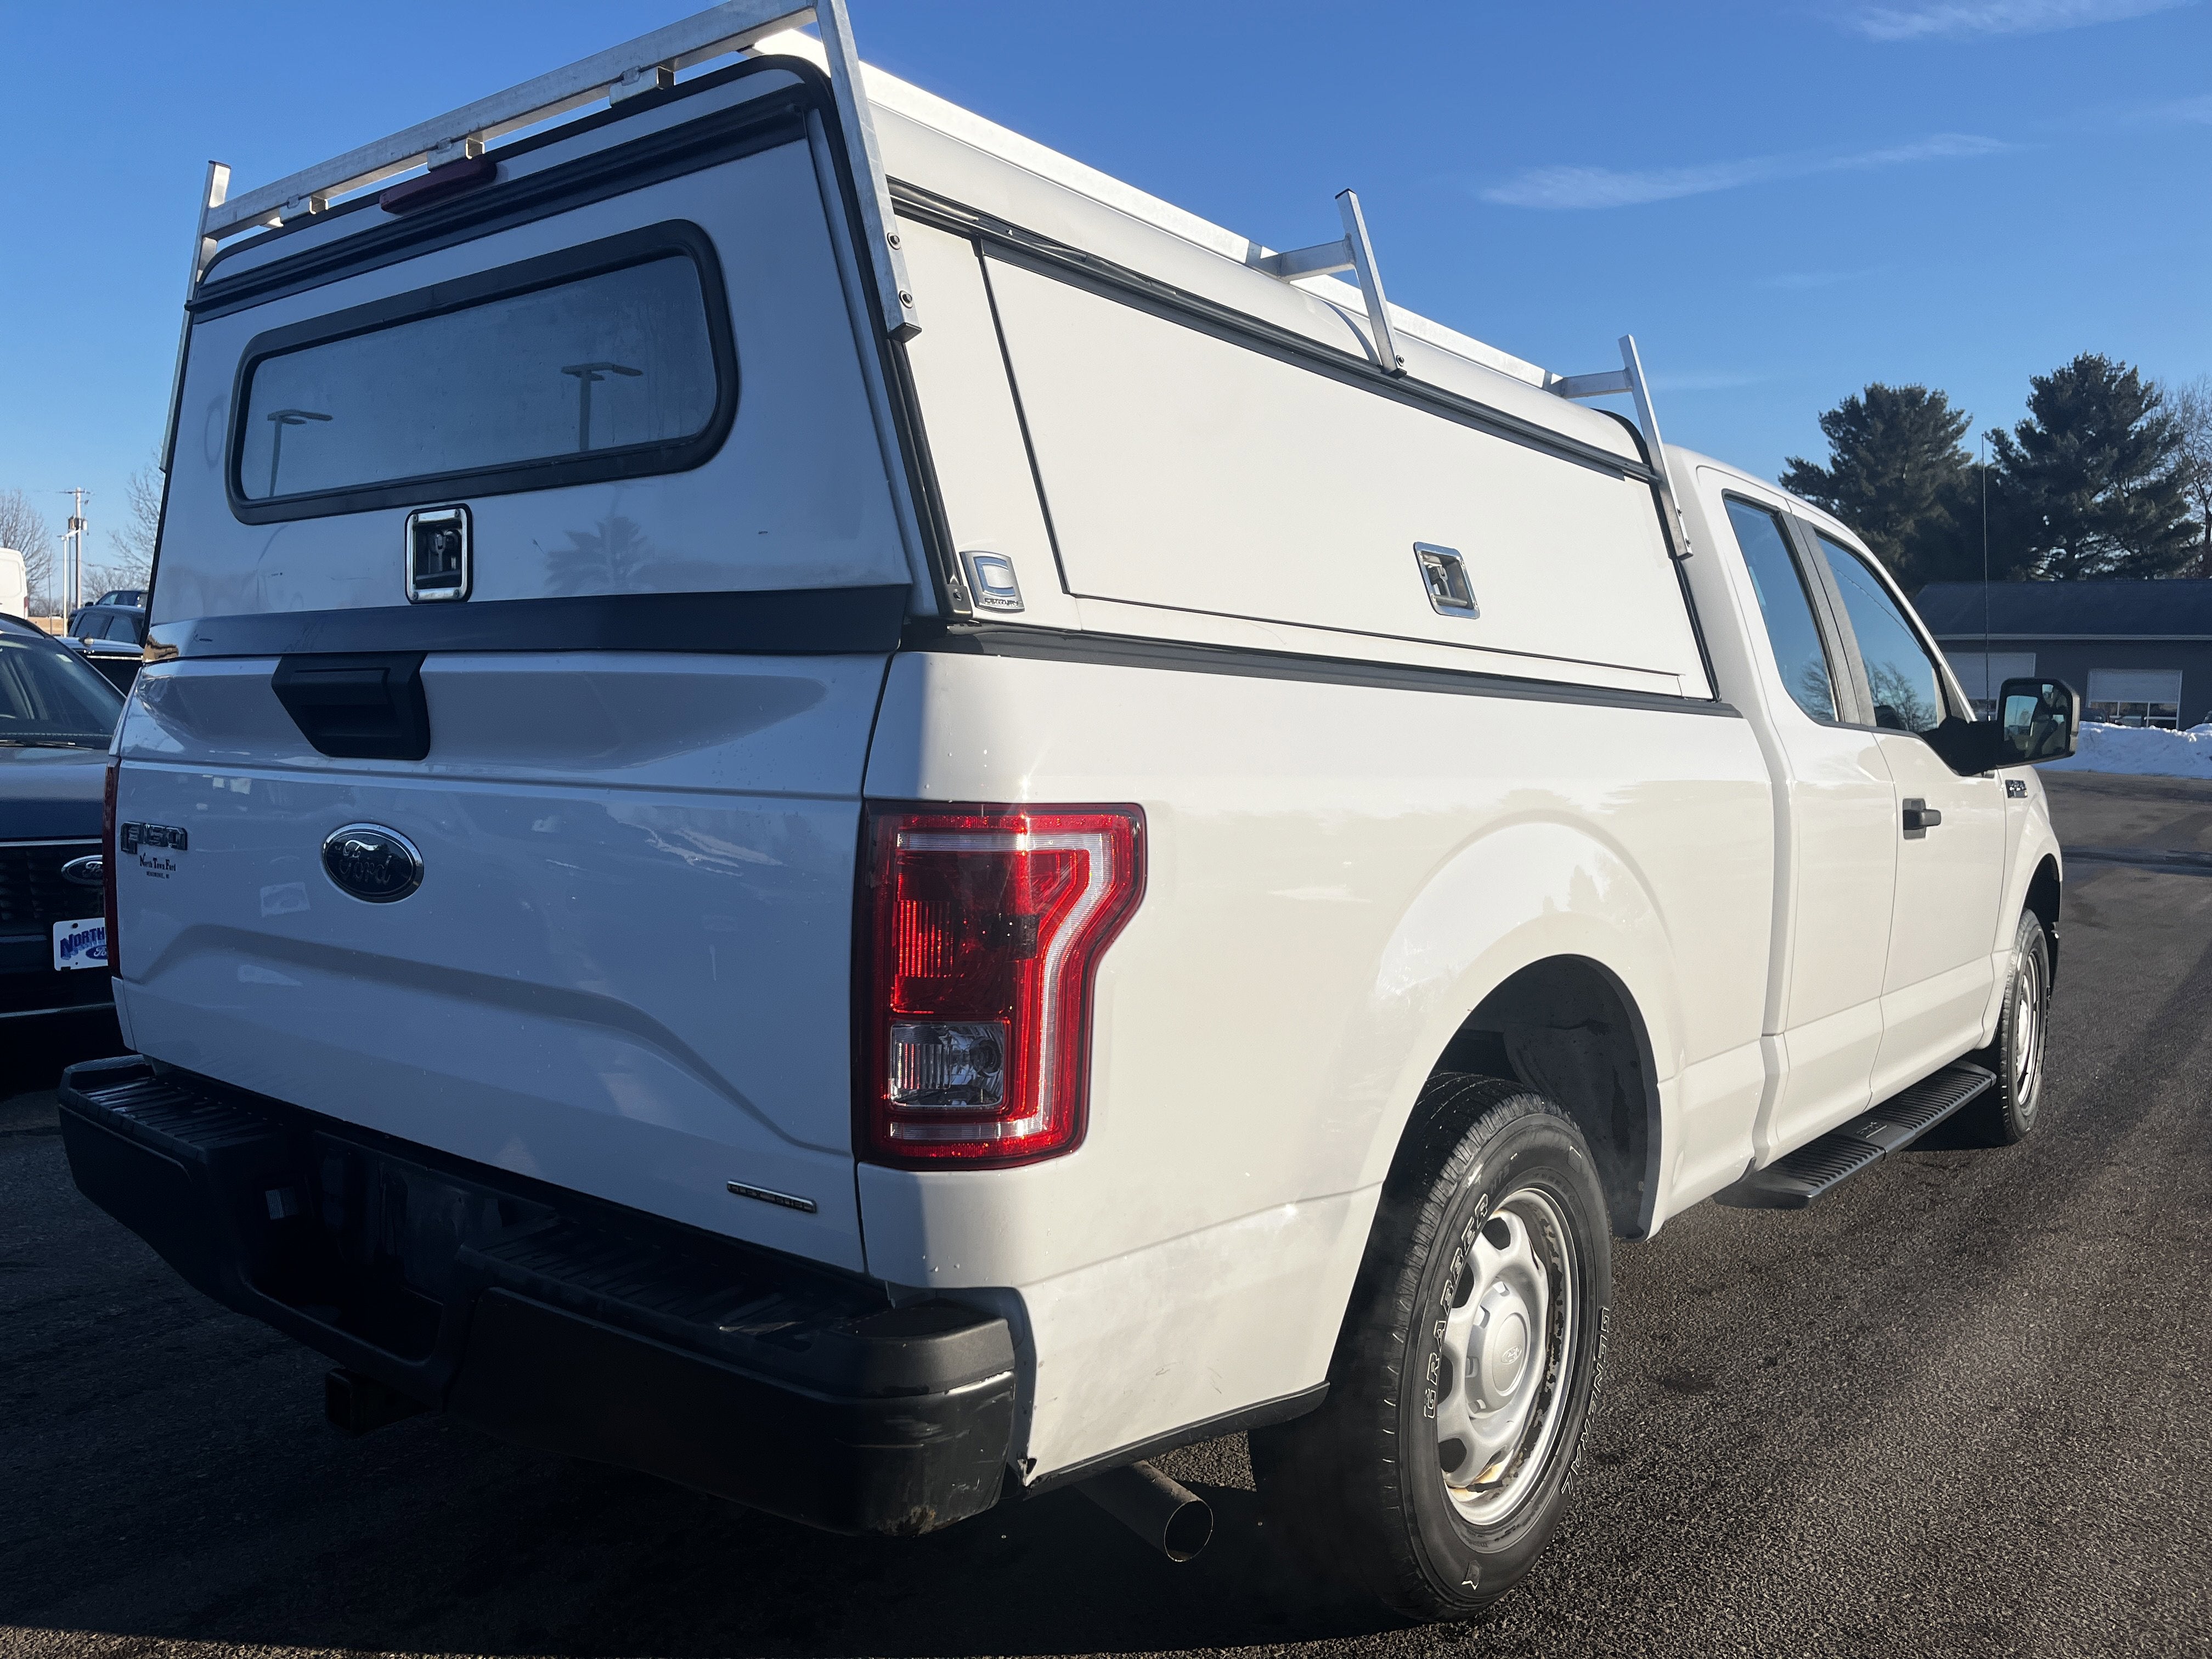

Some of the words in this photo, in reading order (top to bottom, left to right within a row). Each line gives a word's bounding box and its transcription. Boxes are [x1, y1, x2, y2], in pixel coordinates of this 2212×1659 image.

[339, 839, 392, 884] Ford
[1424, 1192, 1489, 1419] GRABBER
[1561, 1306, 1611, 1495] GENERAL
